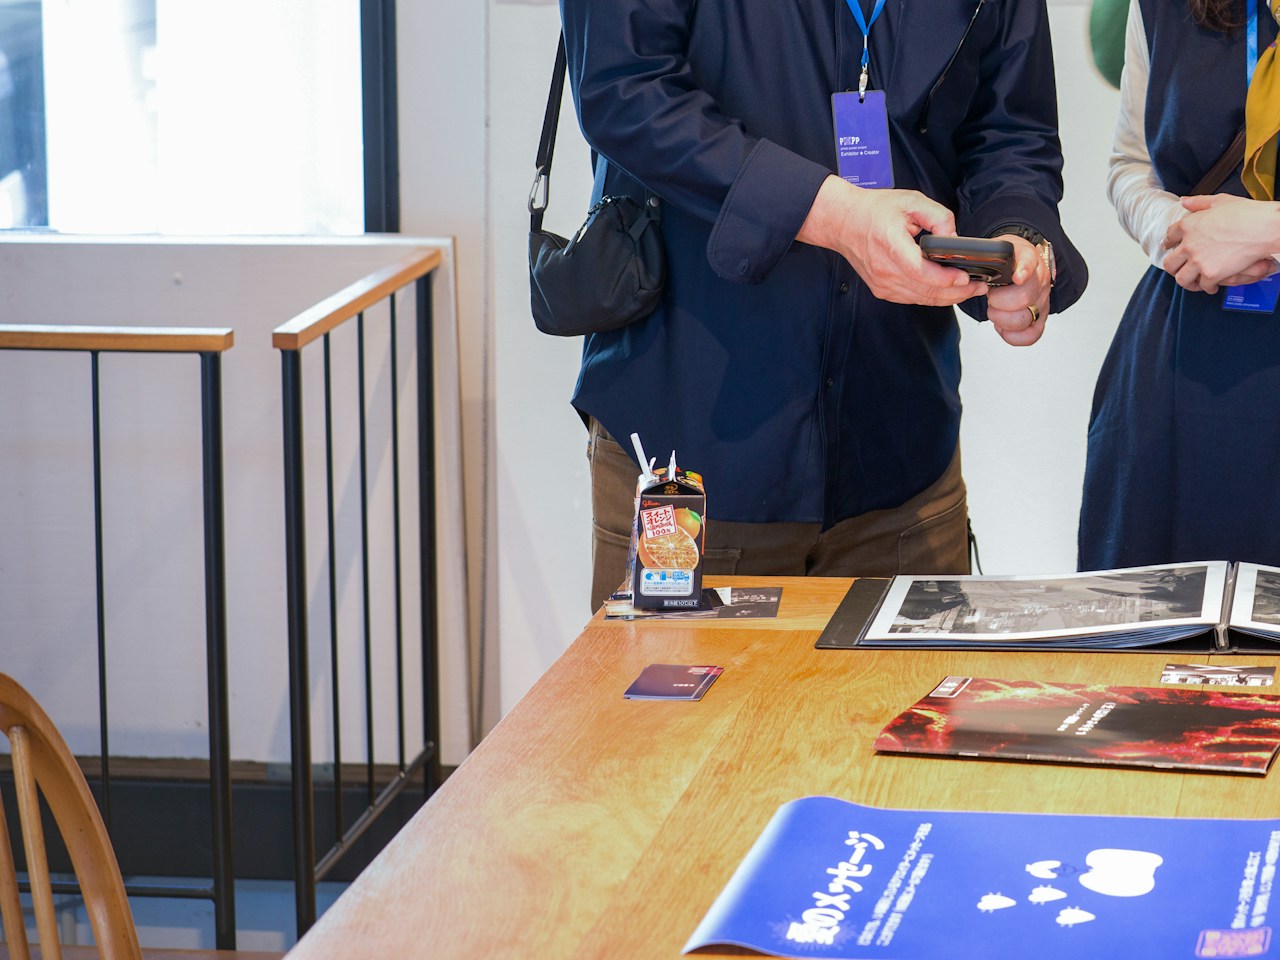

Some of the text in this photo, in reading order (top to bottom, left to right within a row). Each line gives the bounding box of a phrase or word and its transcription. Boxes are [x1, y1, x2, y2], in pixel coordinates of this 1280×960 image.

[646, 509, 670, 518] スイート
[646, 514, 672, 524] オレンジ
